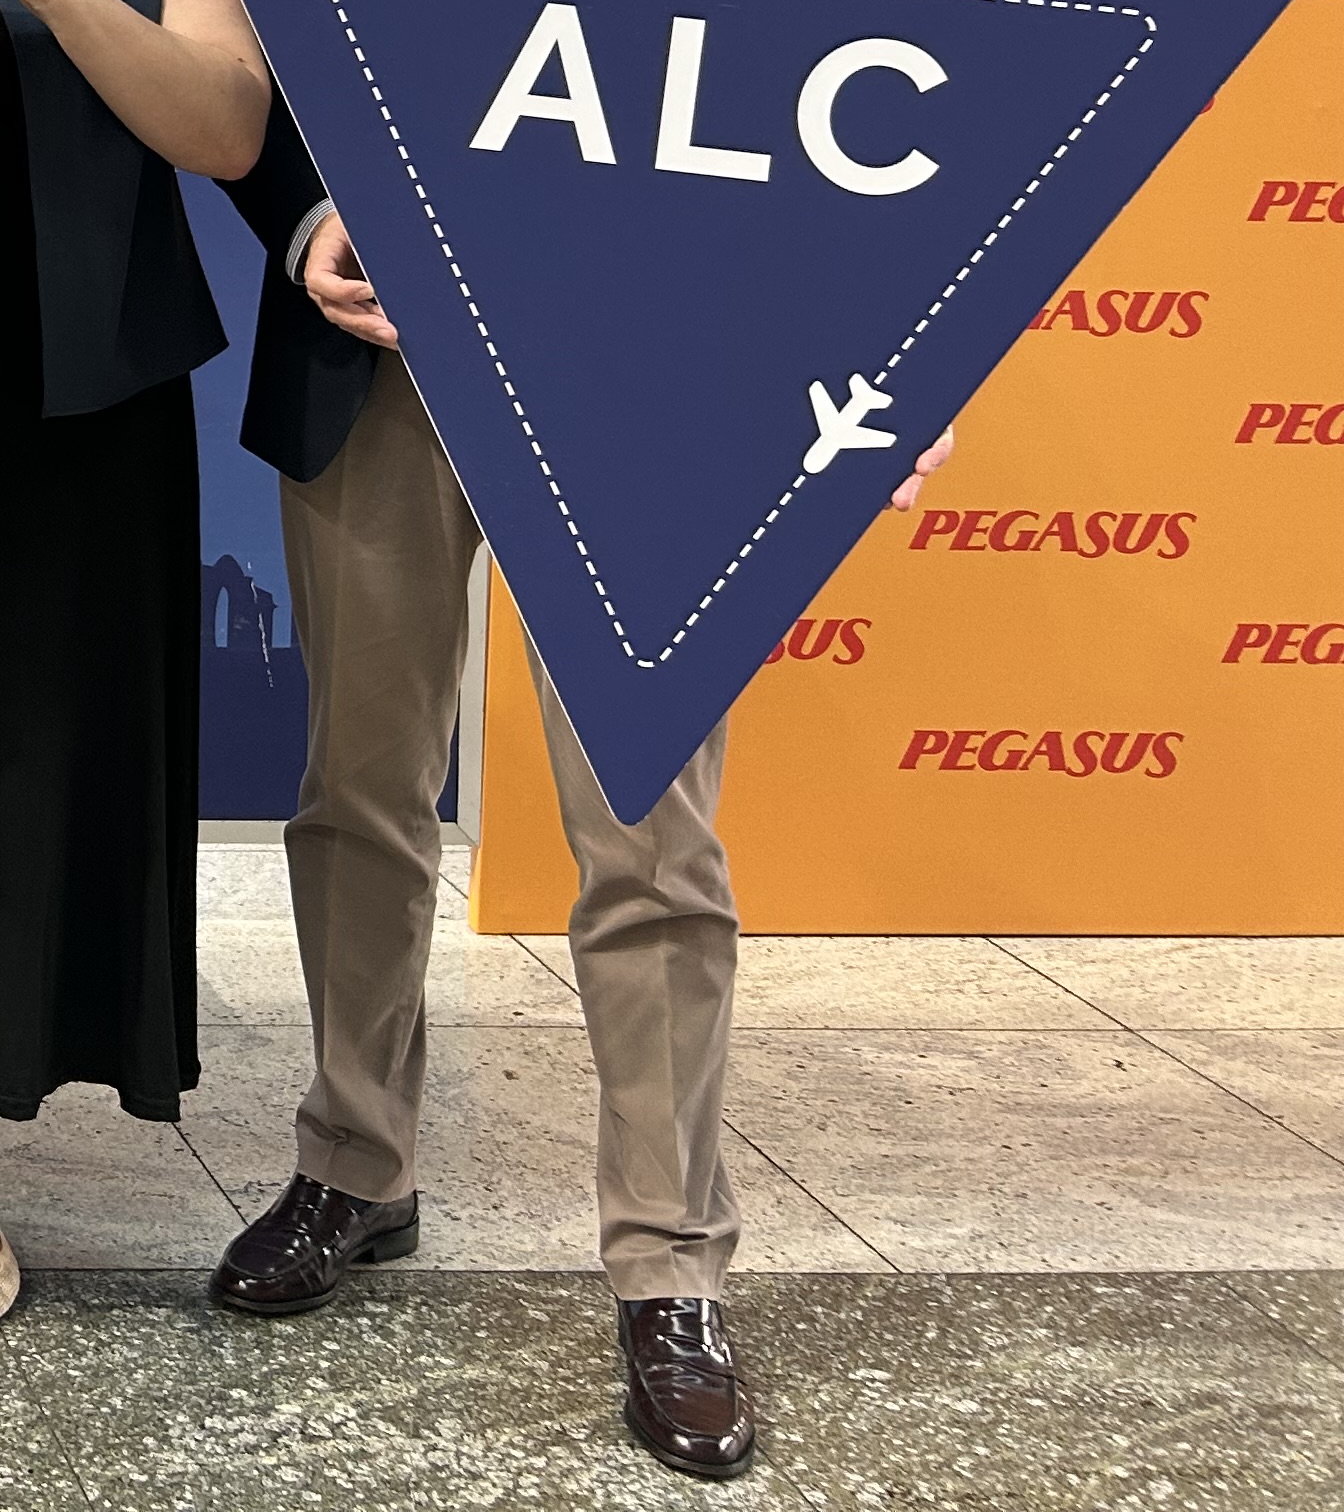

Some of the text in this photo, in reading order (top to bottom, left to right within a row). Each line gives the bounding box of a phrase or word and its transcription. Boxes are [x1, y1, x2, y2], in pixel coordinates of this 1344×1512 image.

[469, 3, 948, 195] ALC
[1026, 289, 1210, 339] ASUS
[909, 510, 1197, 559] PEGASUS
[898, 730, 1184, 778] PEGASUS
